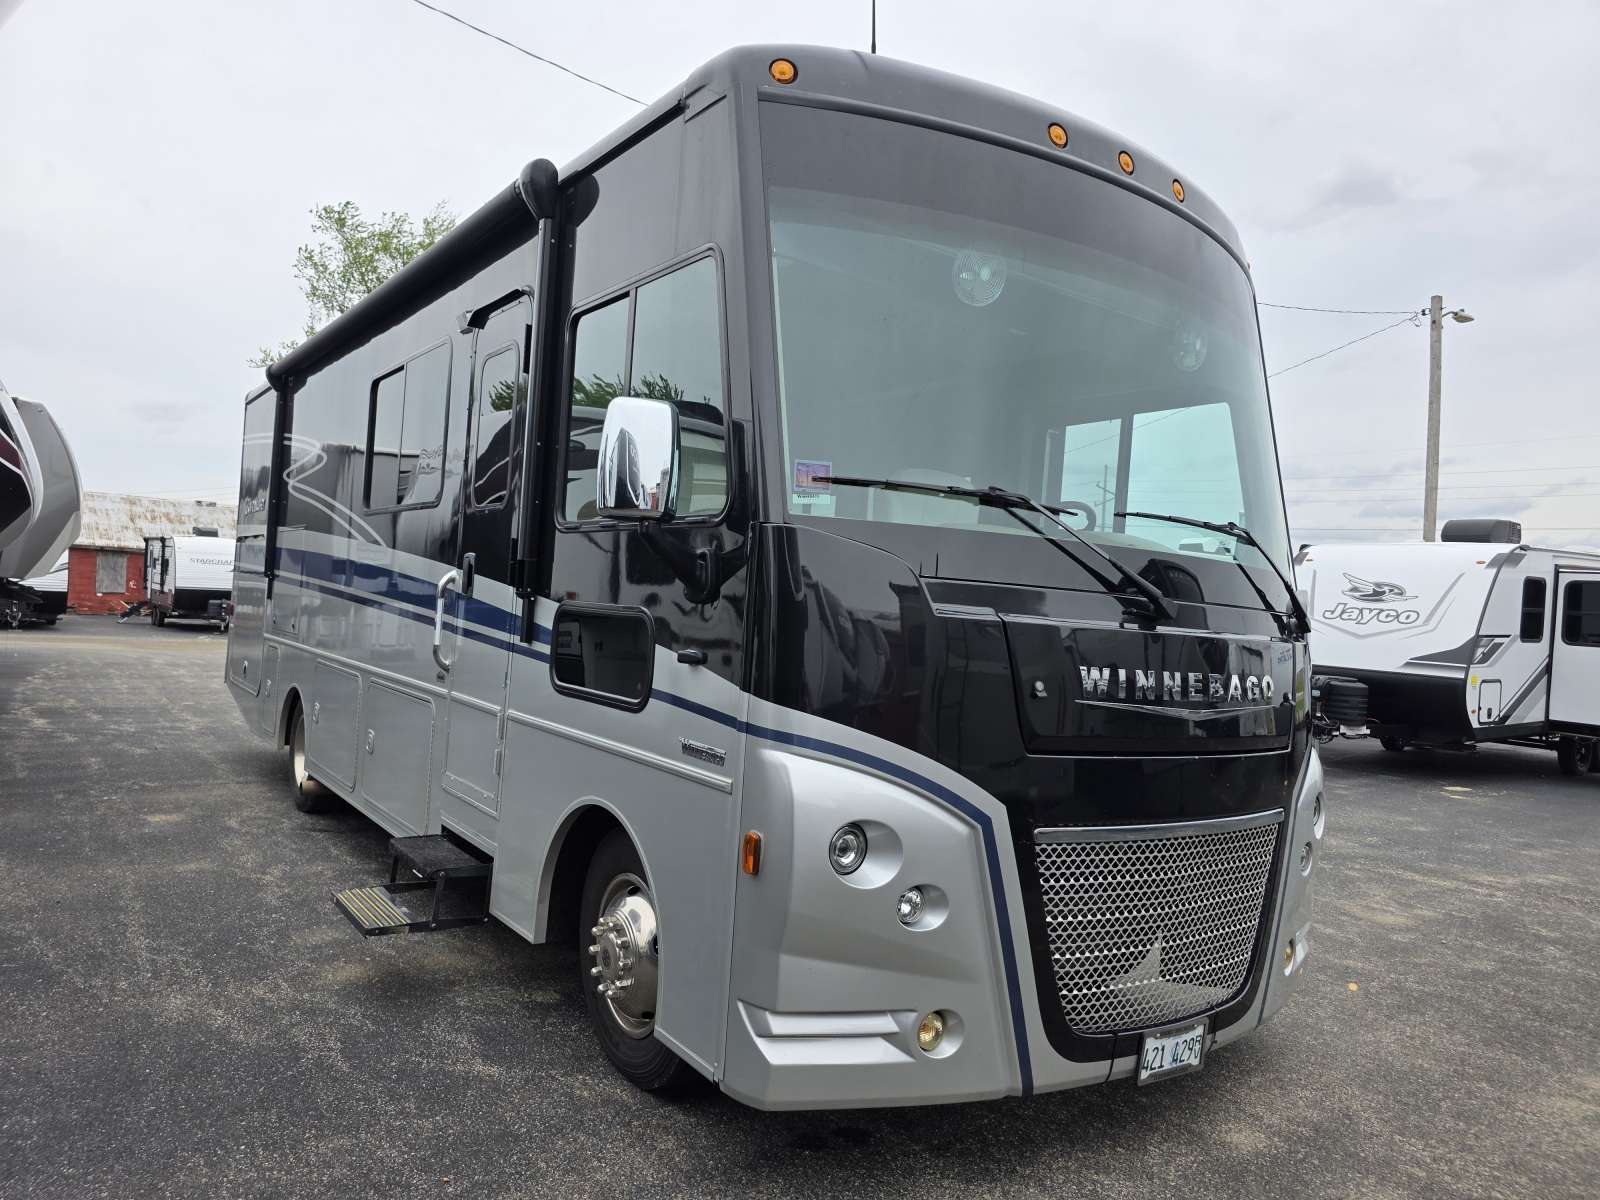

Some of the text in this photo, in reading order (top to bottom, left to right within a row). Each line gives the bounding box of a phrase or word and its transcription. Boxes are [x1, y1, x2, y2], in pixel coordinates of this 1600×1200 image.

[190, 558, 235, 566] STARCRAF
[1323, 602, 1420, 625] Jayco
[1079, 665, 1275, 703] WINNEBAGO
[1141, 1045, 1165, 1072] 421
